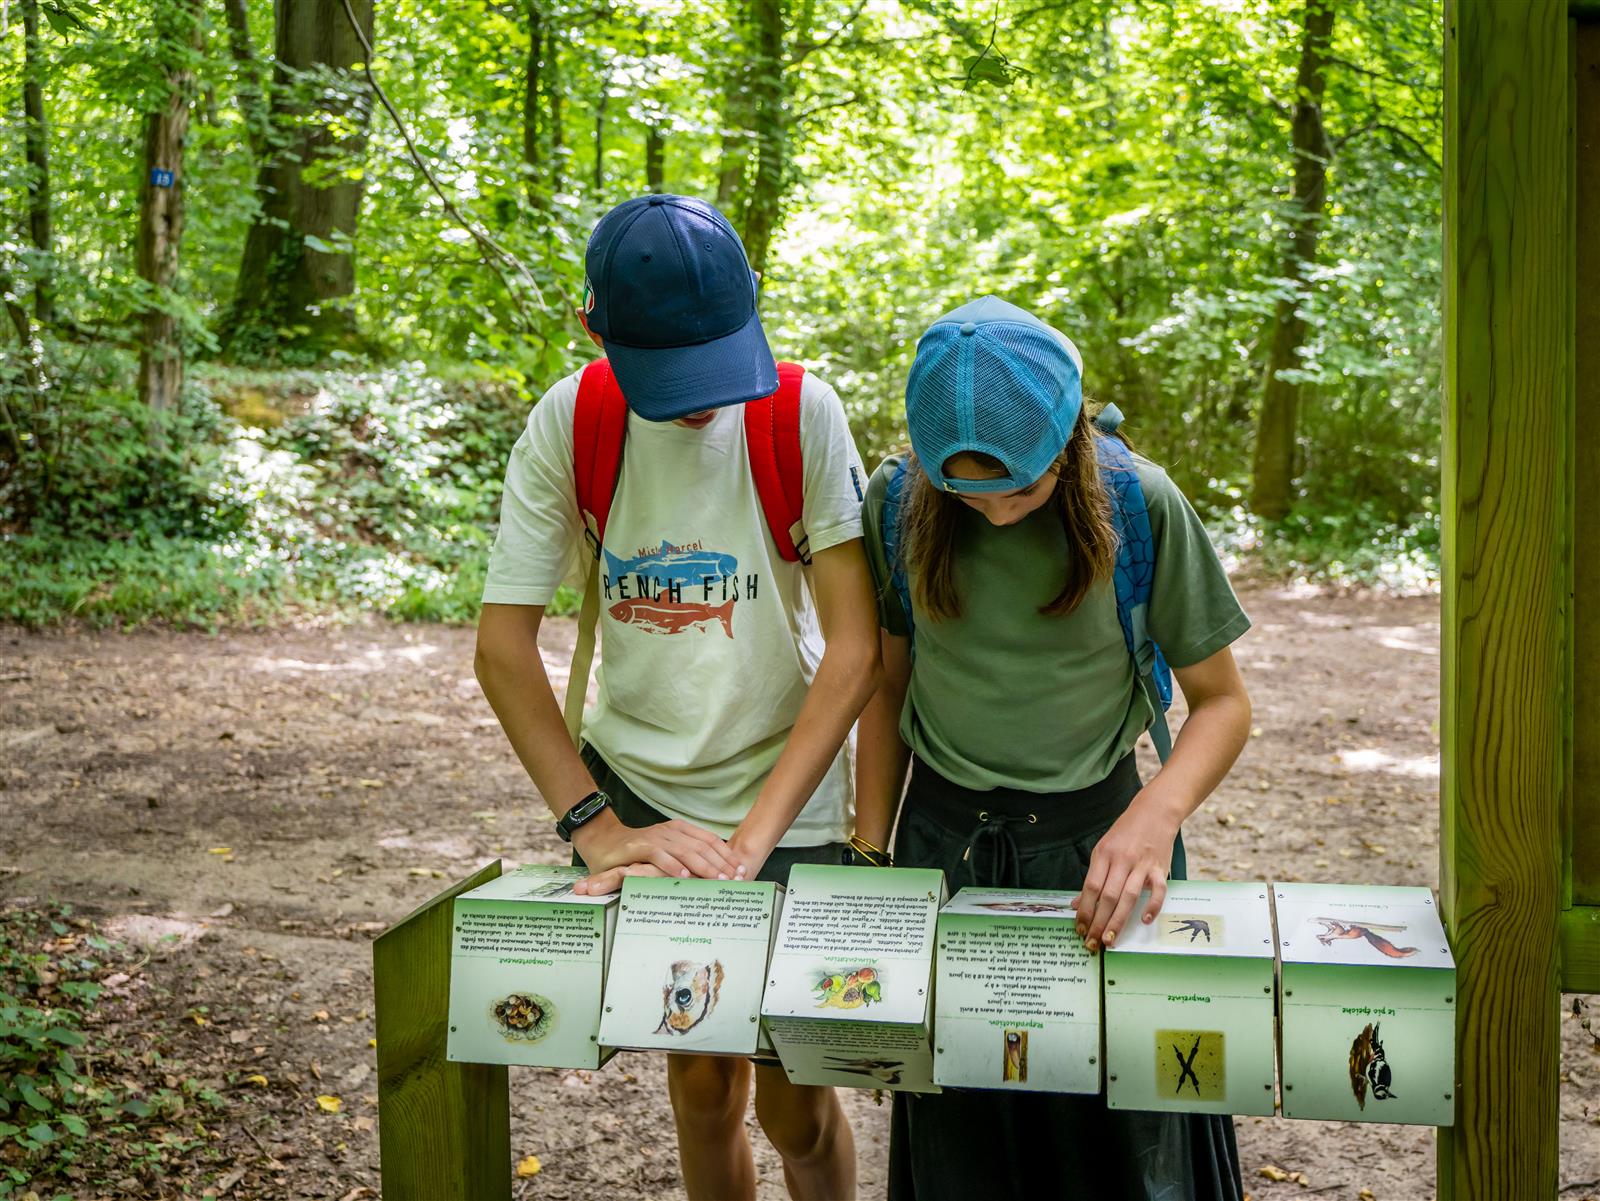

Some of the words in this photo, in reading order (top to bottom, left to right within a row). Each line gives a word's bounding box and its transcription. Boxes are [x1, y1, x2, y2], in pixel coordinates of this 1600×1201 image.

[603, 574, 681, 604] RENCH
[703, 574, 758, 602] FISH
[669, 934, 711, 944] Description
[499, 957, 553, 966] Comportement
[824, 956, 879, 966] Alimentation
[949, 971, 964, 980] jours
[1058, 976, 1076, 984] jeunes
[993, 990, 1007, 998] juin
[1167, 994, 1211, 1003] Empreinte
[987, 998, 1003, 1006] jours
[1373, 1006, 1386, 1016] pic
[989, 1019, 1043, 1029] Reproduction
